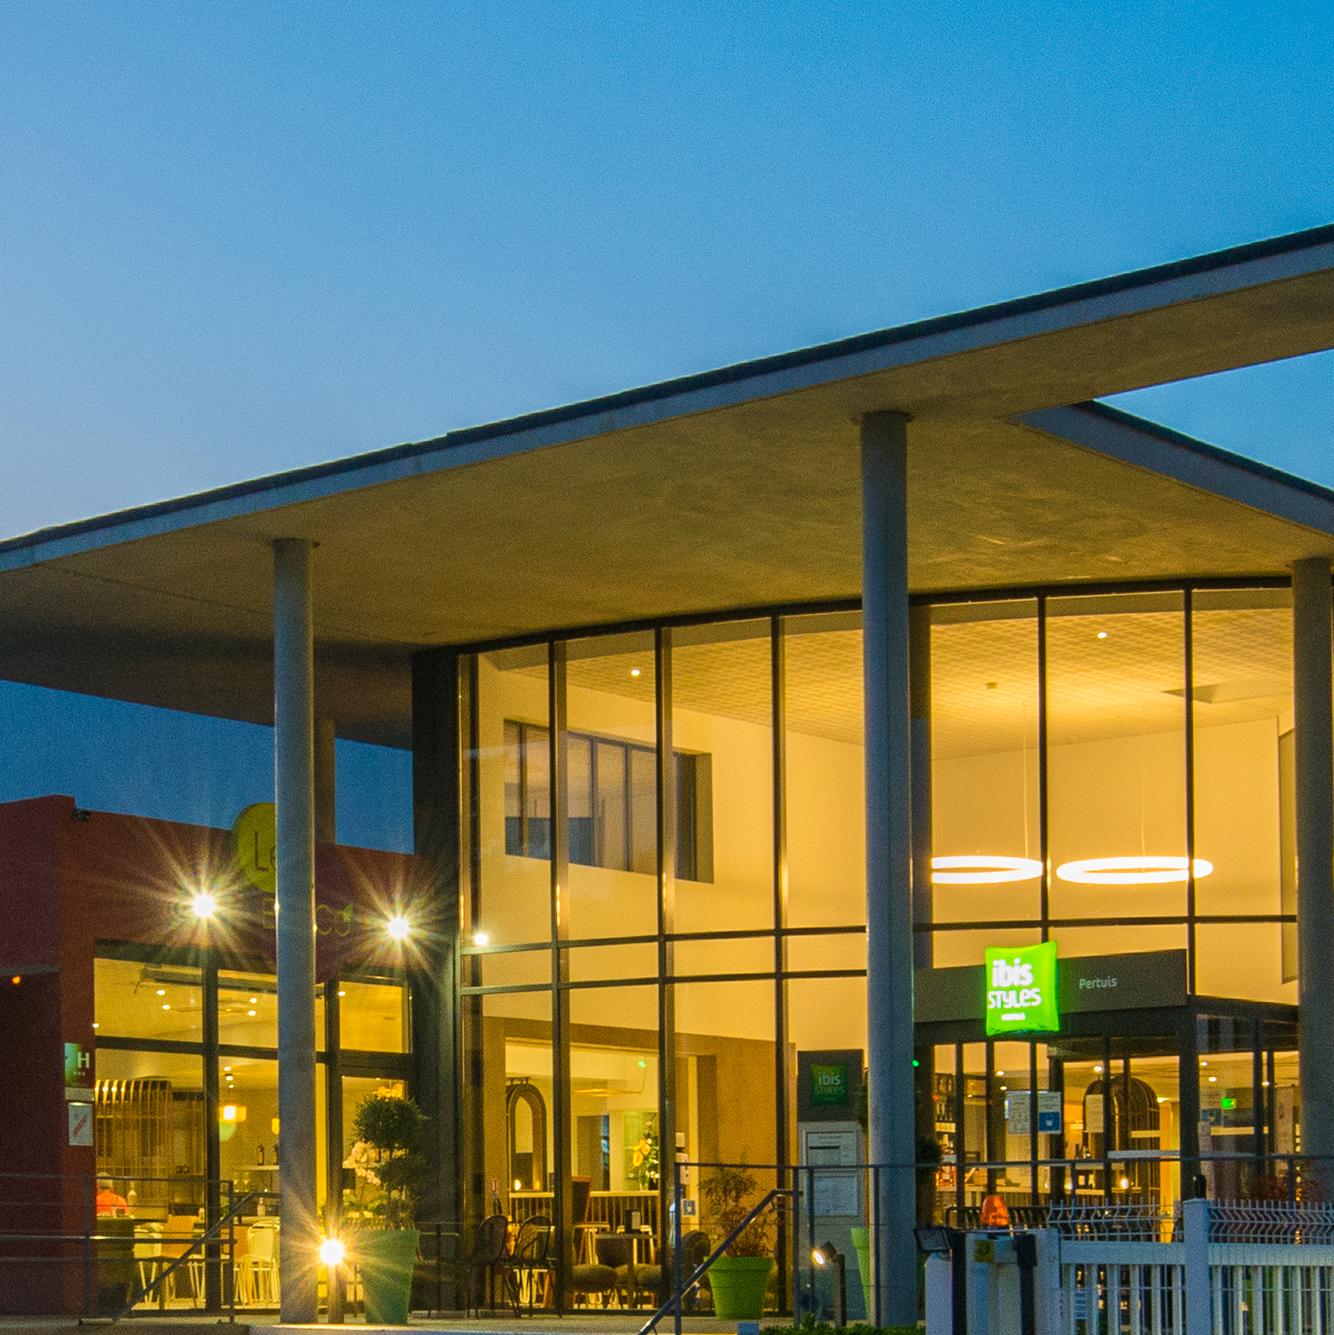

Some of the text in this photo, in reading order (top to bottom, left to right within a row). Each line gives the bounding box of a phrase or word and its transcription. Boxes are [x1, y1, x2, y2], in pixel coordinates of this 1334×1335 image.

[992, 958, 1034, 988] ibis
[1079, 976, 1117, 989] Pertuis
[77, 1052, 90, 1068] H
[819, 1072, 841, 1085] ibis
